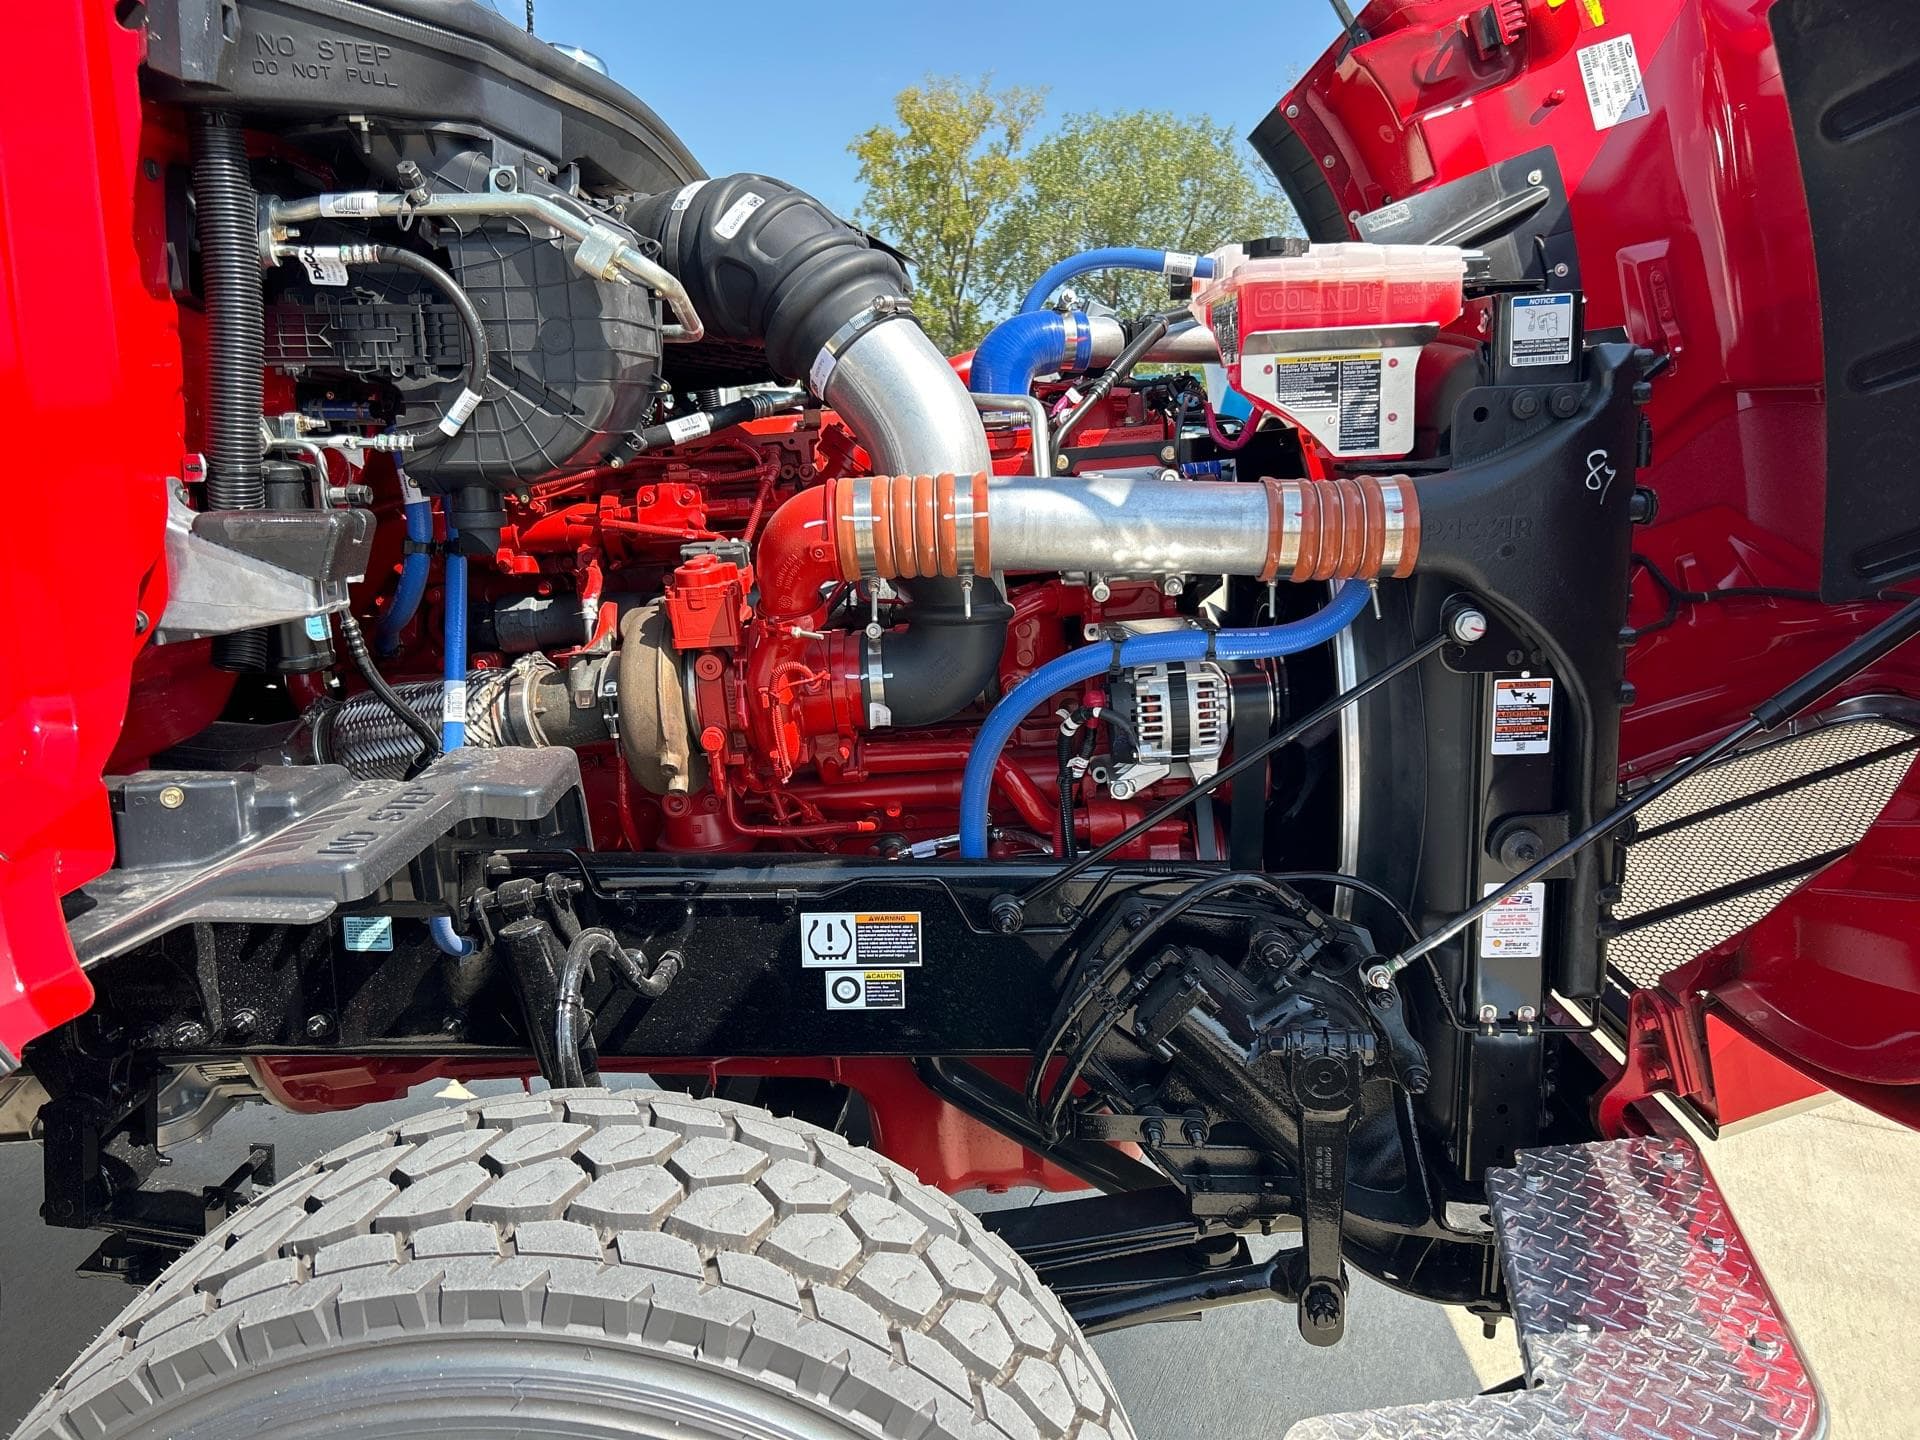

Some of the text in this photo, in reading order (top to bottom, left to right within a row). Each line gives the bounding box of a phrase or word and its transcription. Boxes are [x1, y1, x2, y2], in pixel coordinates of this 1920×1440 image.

[255, 32, 392, 66] NO STEP
[252, 59, 399, 88] DO NOT PULL
[1258, 286, 1355, 312] COOLANT
[1528, 297, 1556, 305] NOTICE
[317, 787, 436, 854] NO STEP
